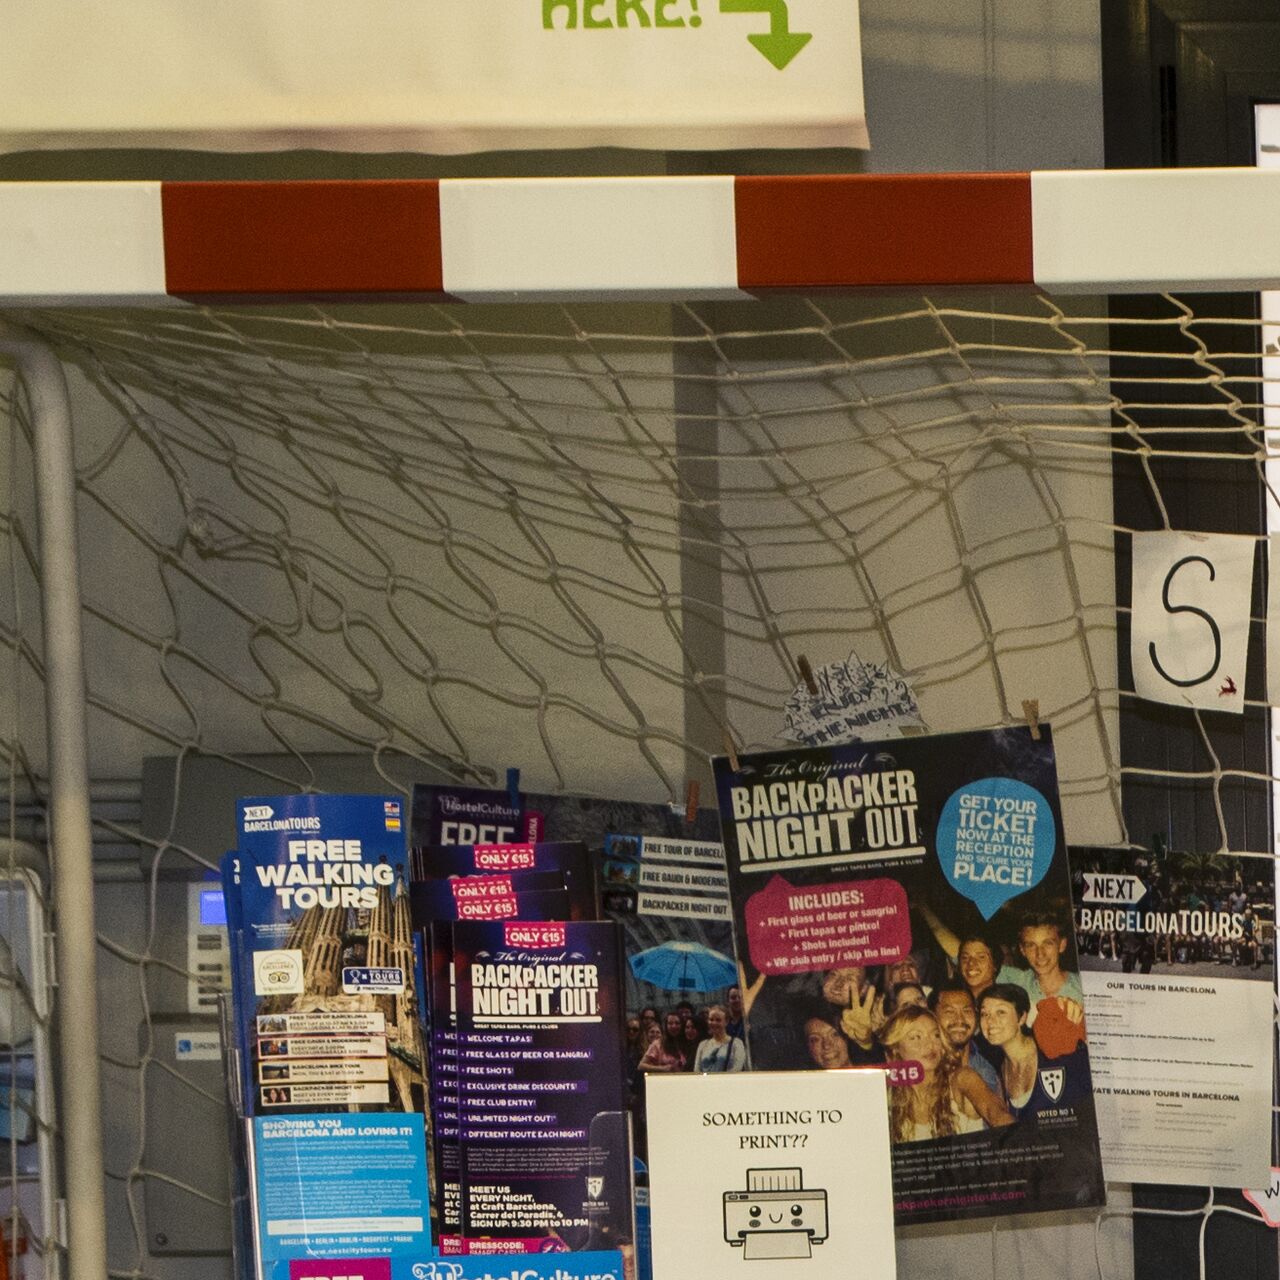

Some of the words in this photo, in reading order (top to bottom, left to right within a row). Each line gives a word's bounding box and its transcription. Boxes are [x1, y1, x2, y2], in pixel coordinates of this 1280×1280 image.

[764, 760, 796, 778] The
[799, 754, 868, 781] Original
[248, 806, 269, 818] NEXT
[960, 794, 991, 809] GET
[993, 798, 1037, 814] YOUR
[244, 817, 321, 833] BARCELONATOURS
[959, 808, 1036, 833] TICKET
[736, 811, 854, 862] NIGHT
[865, 805, 919, 849] OUT
[957, 828, 988, 842] NOW
[991, 832, 1006, 843] AT
[1011, 834, 1034, 847] THE
[288, 839, 362, 862] FREE
[956, 840, 1034, 858] RECEPTION
[480, 854, 509, 865] ONLY
[512, 853, 529, 862] €15
[256, 863, 394, 887] WALKING
[953, 861, 1033, 887] PLACE!
[276, 886, 379, 909] TOURS
[457, 886, 487, 897] ONLY
[489, 884, 508, 895] €15
[1093, 877, 1136, 900] NEXT
[463, 904, 492, 915] ONLY
[495, 902, 512, 913] €15
[788, 890, 865, 911] INCLUDES:
[767, 917, 789, 927] First
[790, 912, 814, 926] glass
[816, 911, 826, 922] of
[827, 910, 847, 921] beer
[850, 909, 859, 918] or
[861, 905, 897, 918] sangria!
[1080, 908, 1243, 939] BARCELONATOURS
[510, 932, 539, 942] ONLY
[542, 931, 560, 942] €15
[788, 928, 809, 938] First
[811, 926, 835, 938] tapas
[837, 924, 847, 933] or
[849, 920, 880, 934] pintxo!
[801, 939, 826, 950] Shots
[829, 936, 870, 948] included!
[494, 951, 514, 962] The
[518, 951, 564, 969] Original
[1107, 982, 1125, 990] OUR
[1129, 983, 1156, 991] TOURS
[1158, 984, 1167, 992] IN
[1168, 985, 1217, 995] BARCELONA
[472, 988, 553, 1016] NIGHT
[561, 988, 599, 1016] OUT
[467, 1035, 503, 1043] WELCOME
[466, 1066, 484, 1075] FREE
[486, 1066, 514, 1075] SHOTS!
[890, 1067, 919, 1081] €15
[1113, 1088, 1151, 1097] WALKING
[1153, 1090, 1180, 1099] TOURS
[1182, 1091, 1190, 1099] IN
[1192, 1092, 1240, 1102] BARCELONA
[262, 1120, 315, 1130] SHOWING
[318, 1119, 341, 1129] YOU
[702, 1110, 812, 1127] SOMETHING
[817, 1109, 843, 1124] TO
[263, 1128, 330, 1138] BARCELONA
[333, 1128, 356, 1137] AND
[358, 1127, 398, 1136] LOVING
[400, 1127, 413, 1136] IT!
[739, 1134, 809, 1150] PRINT??
[469, 1186, 495, 1194] MEET
[470, 1194, 500, 1202] EVERY
